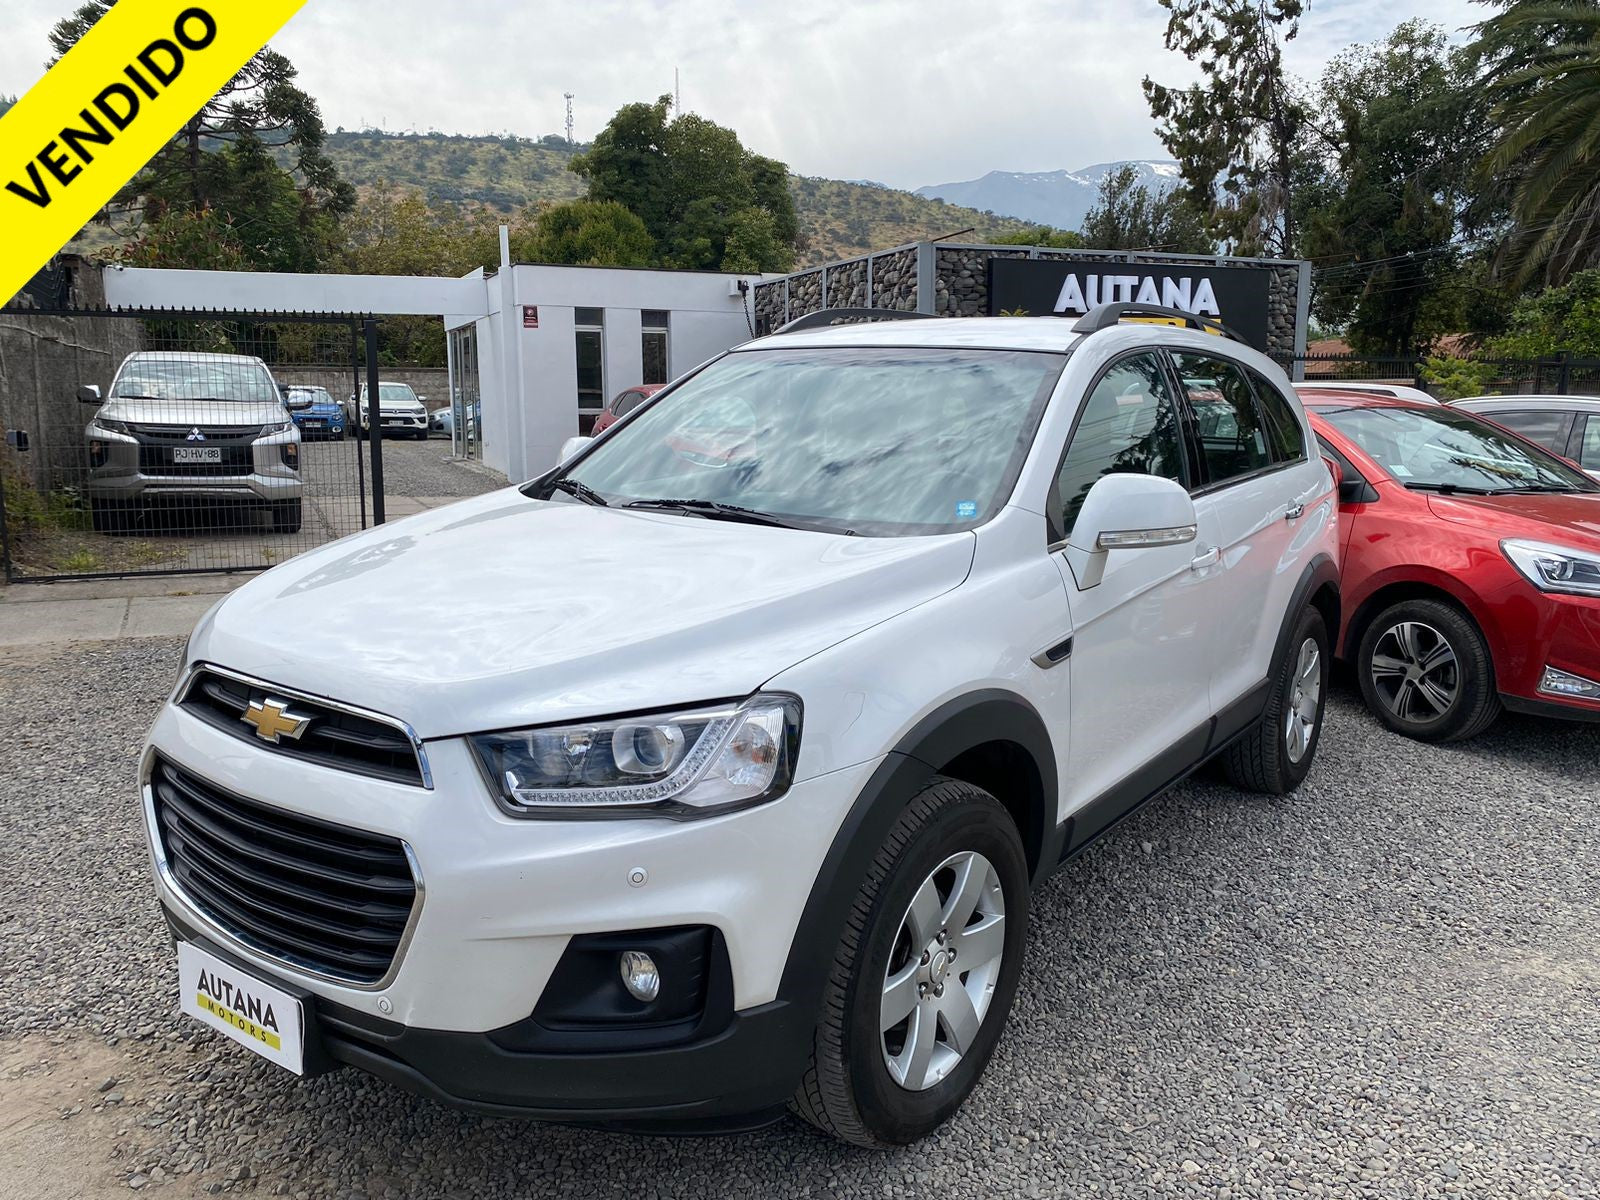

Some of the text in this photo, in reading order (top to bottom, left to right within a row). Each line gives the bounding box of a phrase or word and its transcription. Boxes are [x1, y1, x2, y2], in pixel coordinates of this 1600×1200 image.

[1053, 273, 1221, 316] AUTANA
[197, 968, 279, 1033] AUTANA
[207, 999, 267, 1042] MOTORS
